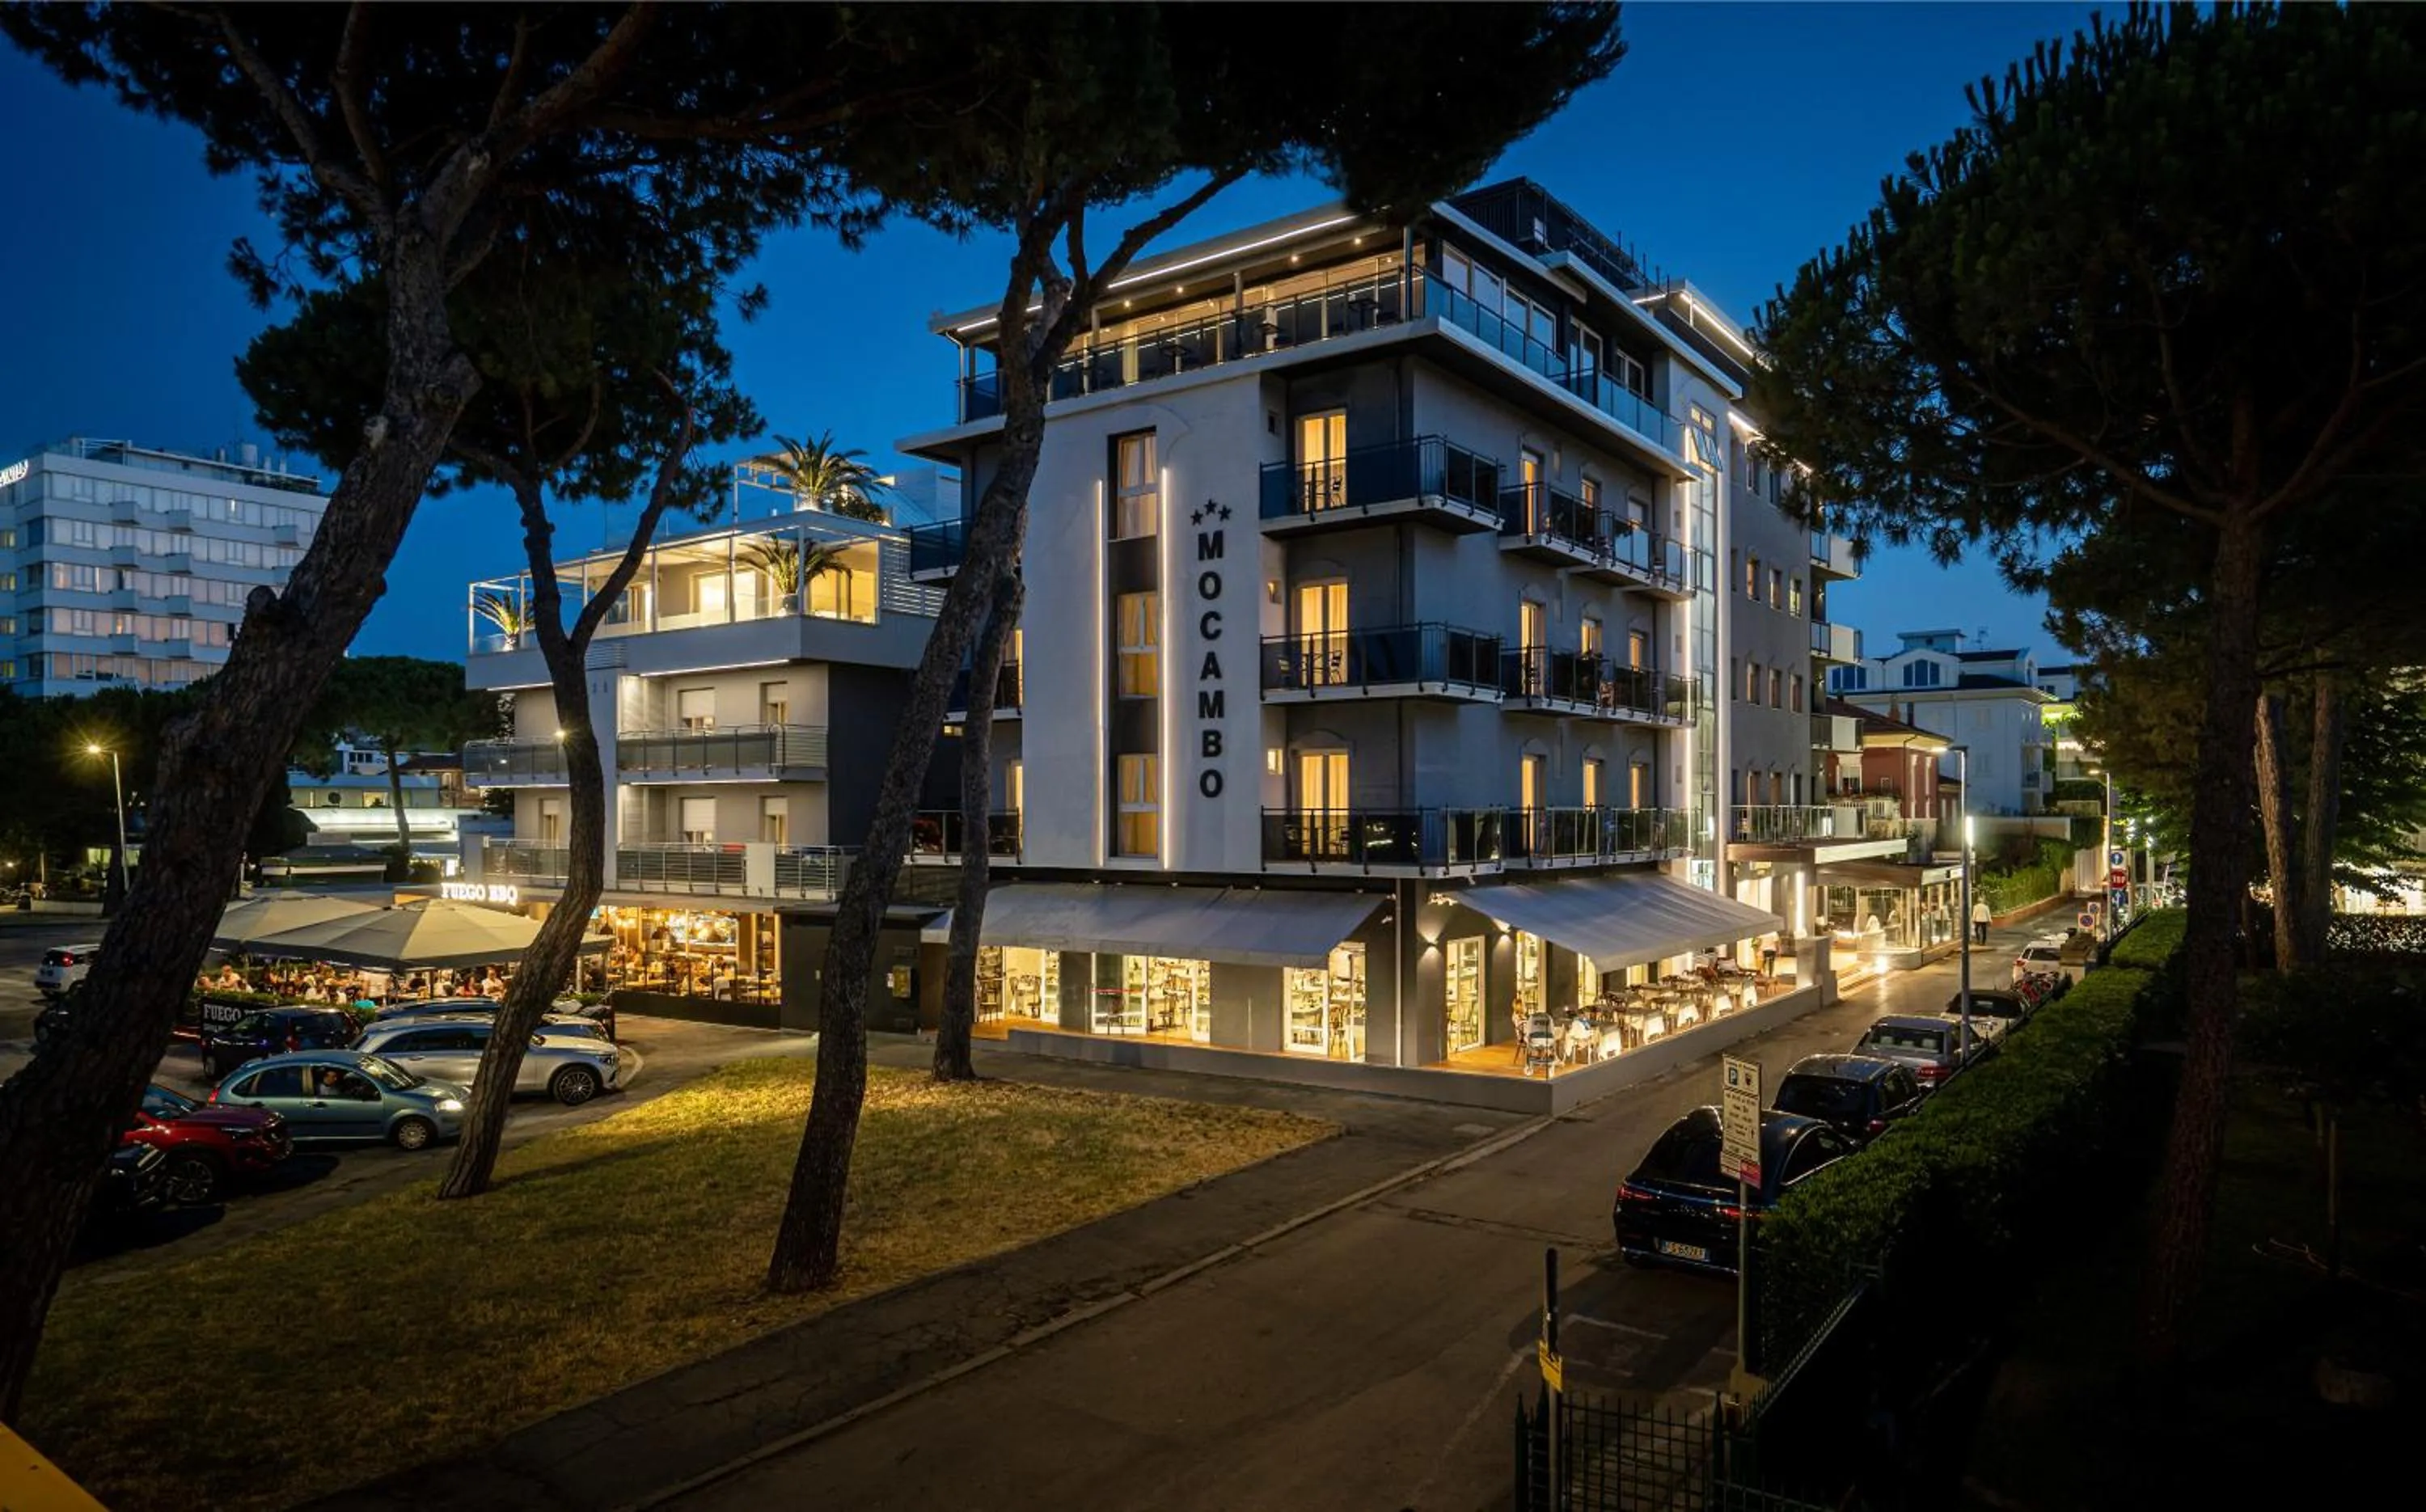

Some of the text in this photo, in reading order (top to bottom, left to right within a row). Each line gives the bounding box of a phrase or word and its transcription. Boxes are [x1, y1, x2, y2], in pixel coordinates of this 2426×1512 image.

[1198, 530, 1224, 799] MOCAMBO
[441, 882, 518, 906] FUEGO BBQ
[203, 1003, 243, 1023] FUEGO
